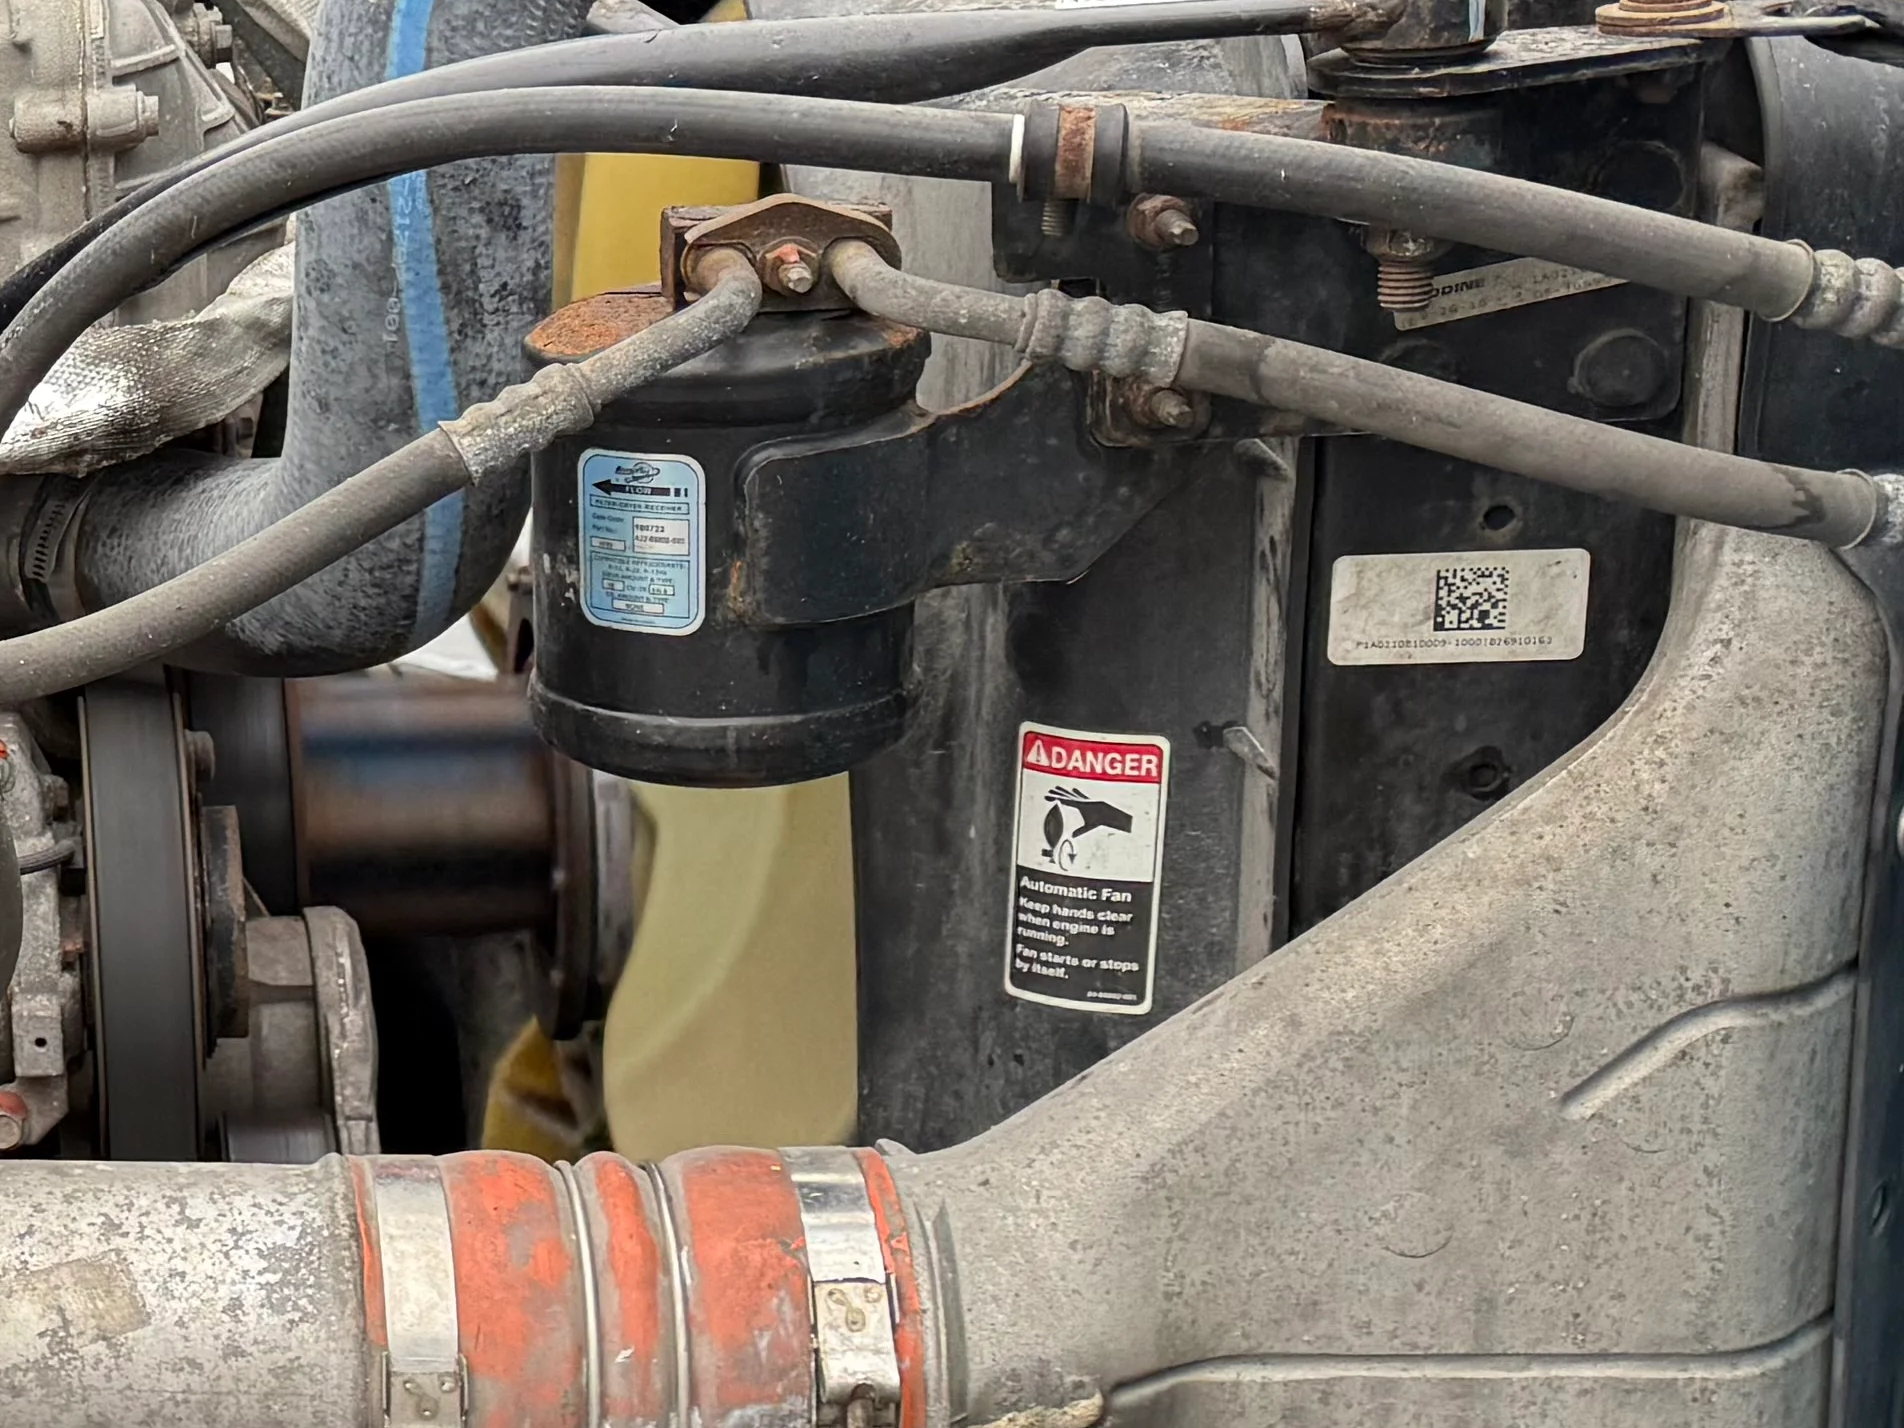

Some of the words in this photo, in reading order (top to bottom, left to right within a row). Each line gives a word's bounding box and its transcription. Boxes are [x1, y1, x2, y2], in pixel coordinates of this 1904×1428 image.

[625, 486, 652, 495] FLOW
[1051, 748, 1157, 777] DANGER
[1020, 876, 1097, 900] Automatic
[1101, 887, 1132, 903] Fan
[1019, 896, 1051, 916] Keep
[1052, 903, 1095, 921] hands
[1097, 910, 1133, 923] clear
[1017, 912, 1051, 928] when
[1052, 919, 1099, 937] engine
[1101, 924, 1115, 936] is
[1017, 926, 1069, 947] running.
[1014, 958, 1030, 974] by
[1031, 961, 1069, 979] itself.
[1016, 943, 1038, 959] Fan
[1040, 951, 1079, 967] starts
[1081, 958, 1098, 967] or
[1099, 959, 1139, 973] stops
